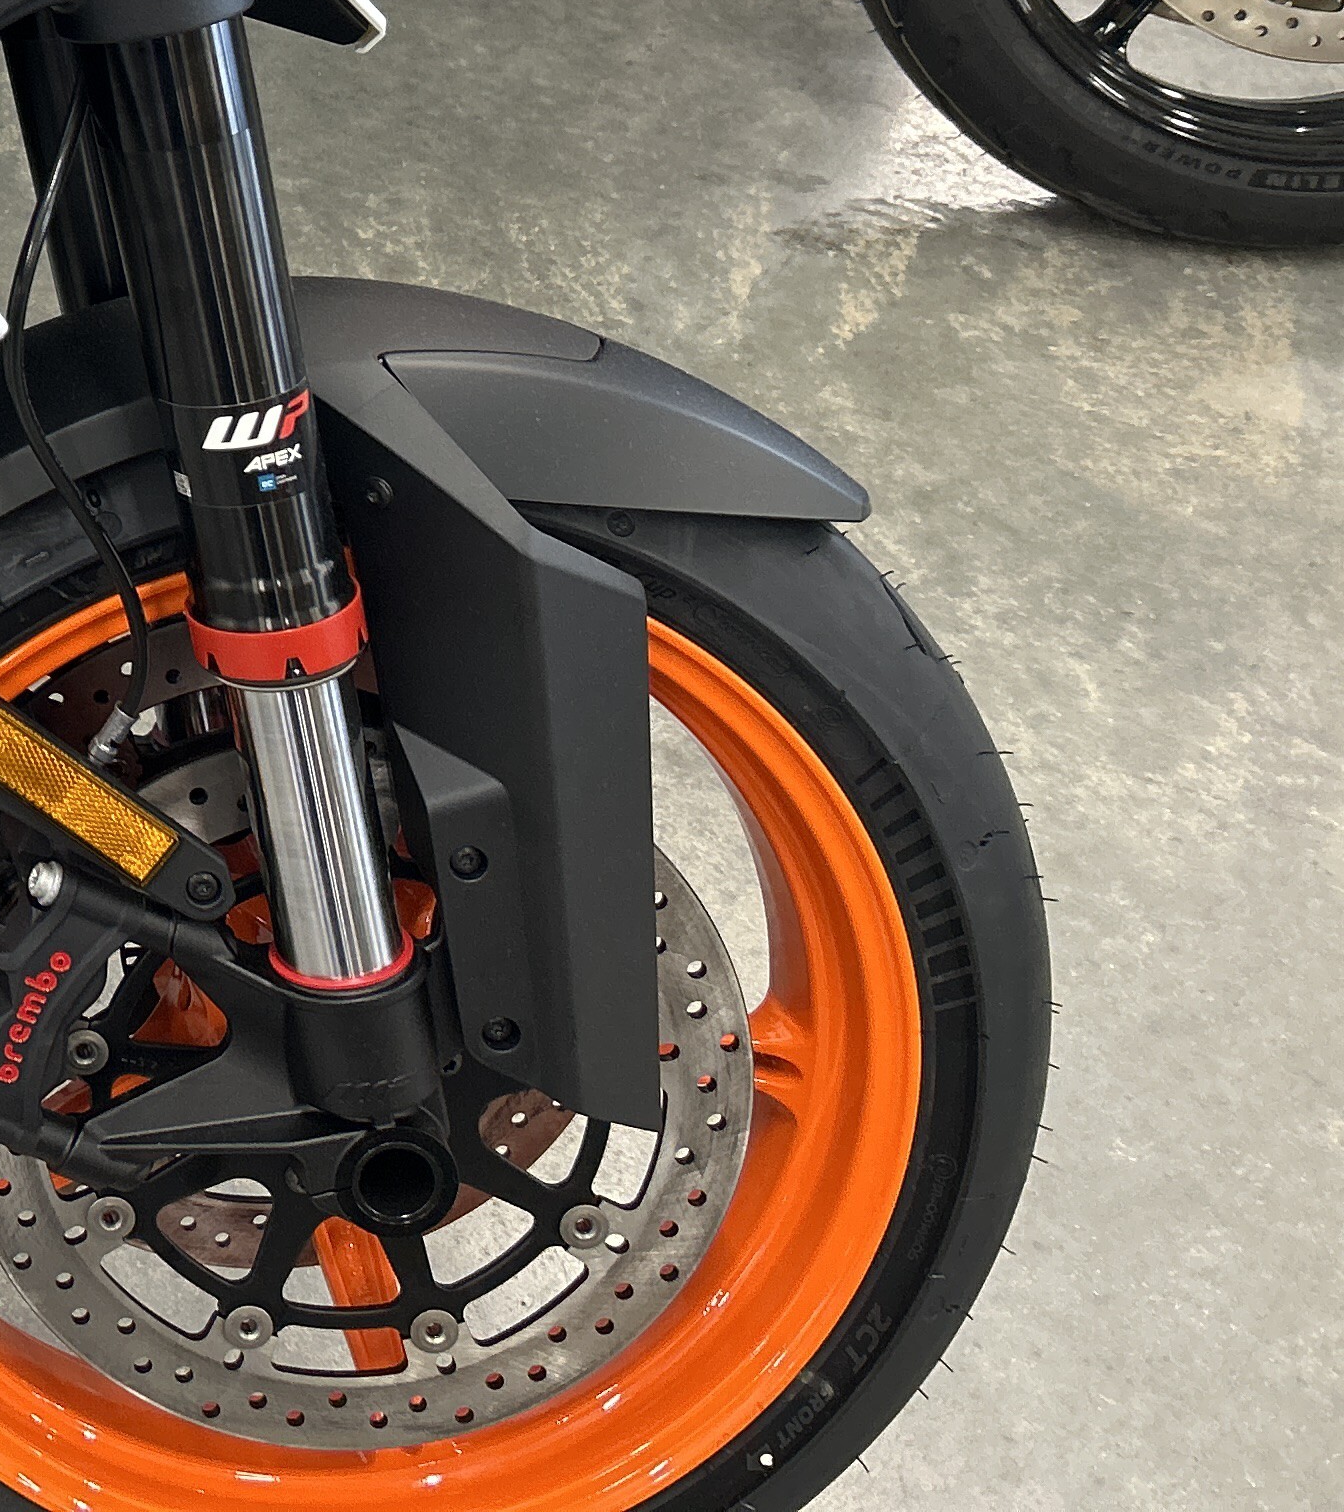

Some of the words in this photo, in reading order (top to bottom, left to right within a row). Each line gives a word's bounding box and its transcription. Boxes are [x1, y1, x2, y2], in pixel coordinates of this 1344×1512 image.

[202, 388, 310, 451] WP
[243, 442, 303, 473] APEX
[844, 1301, 893, 1374] 2CT
